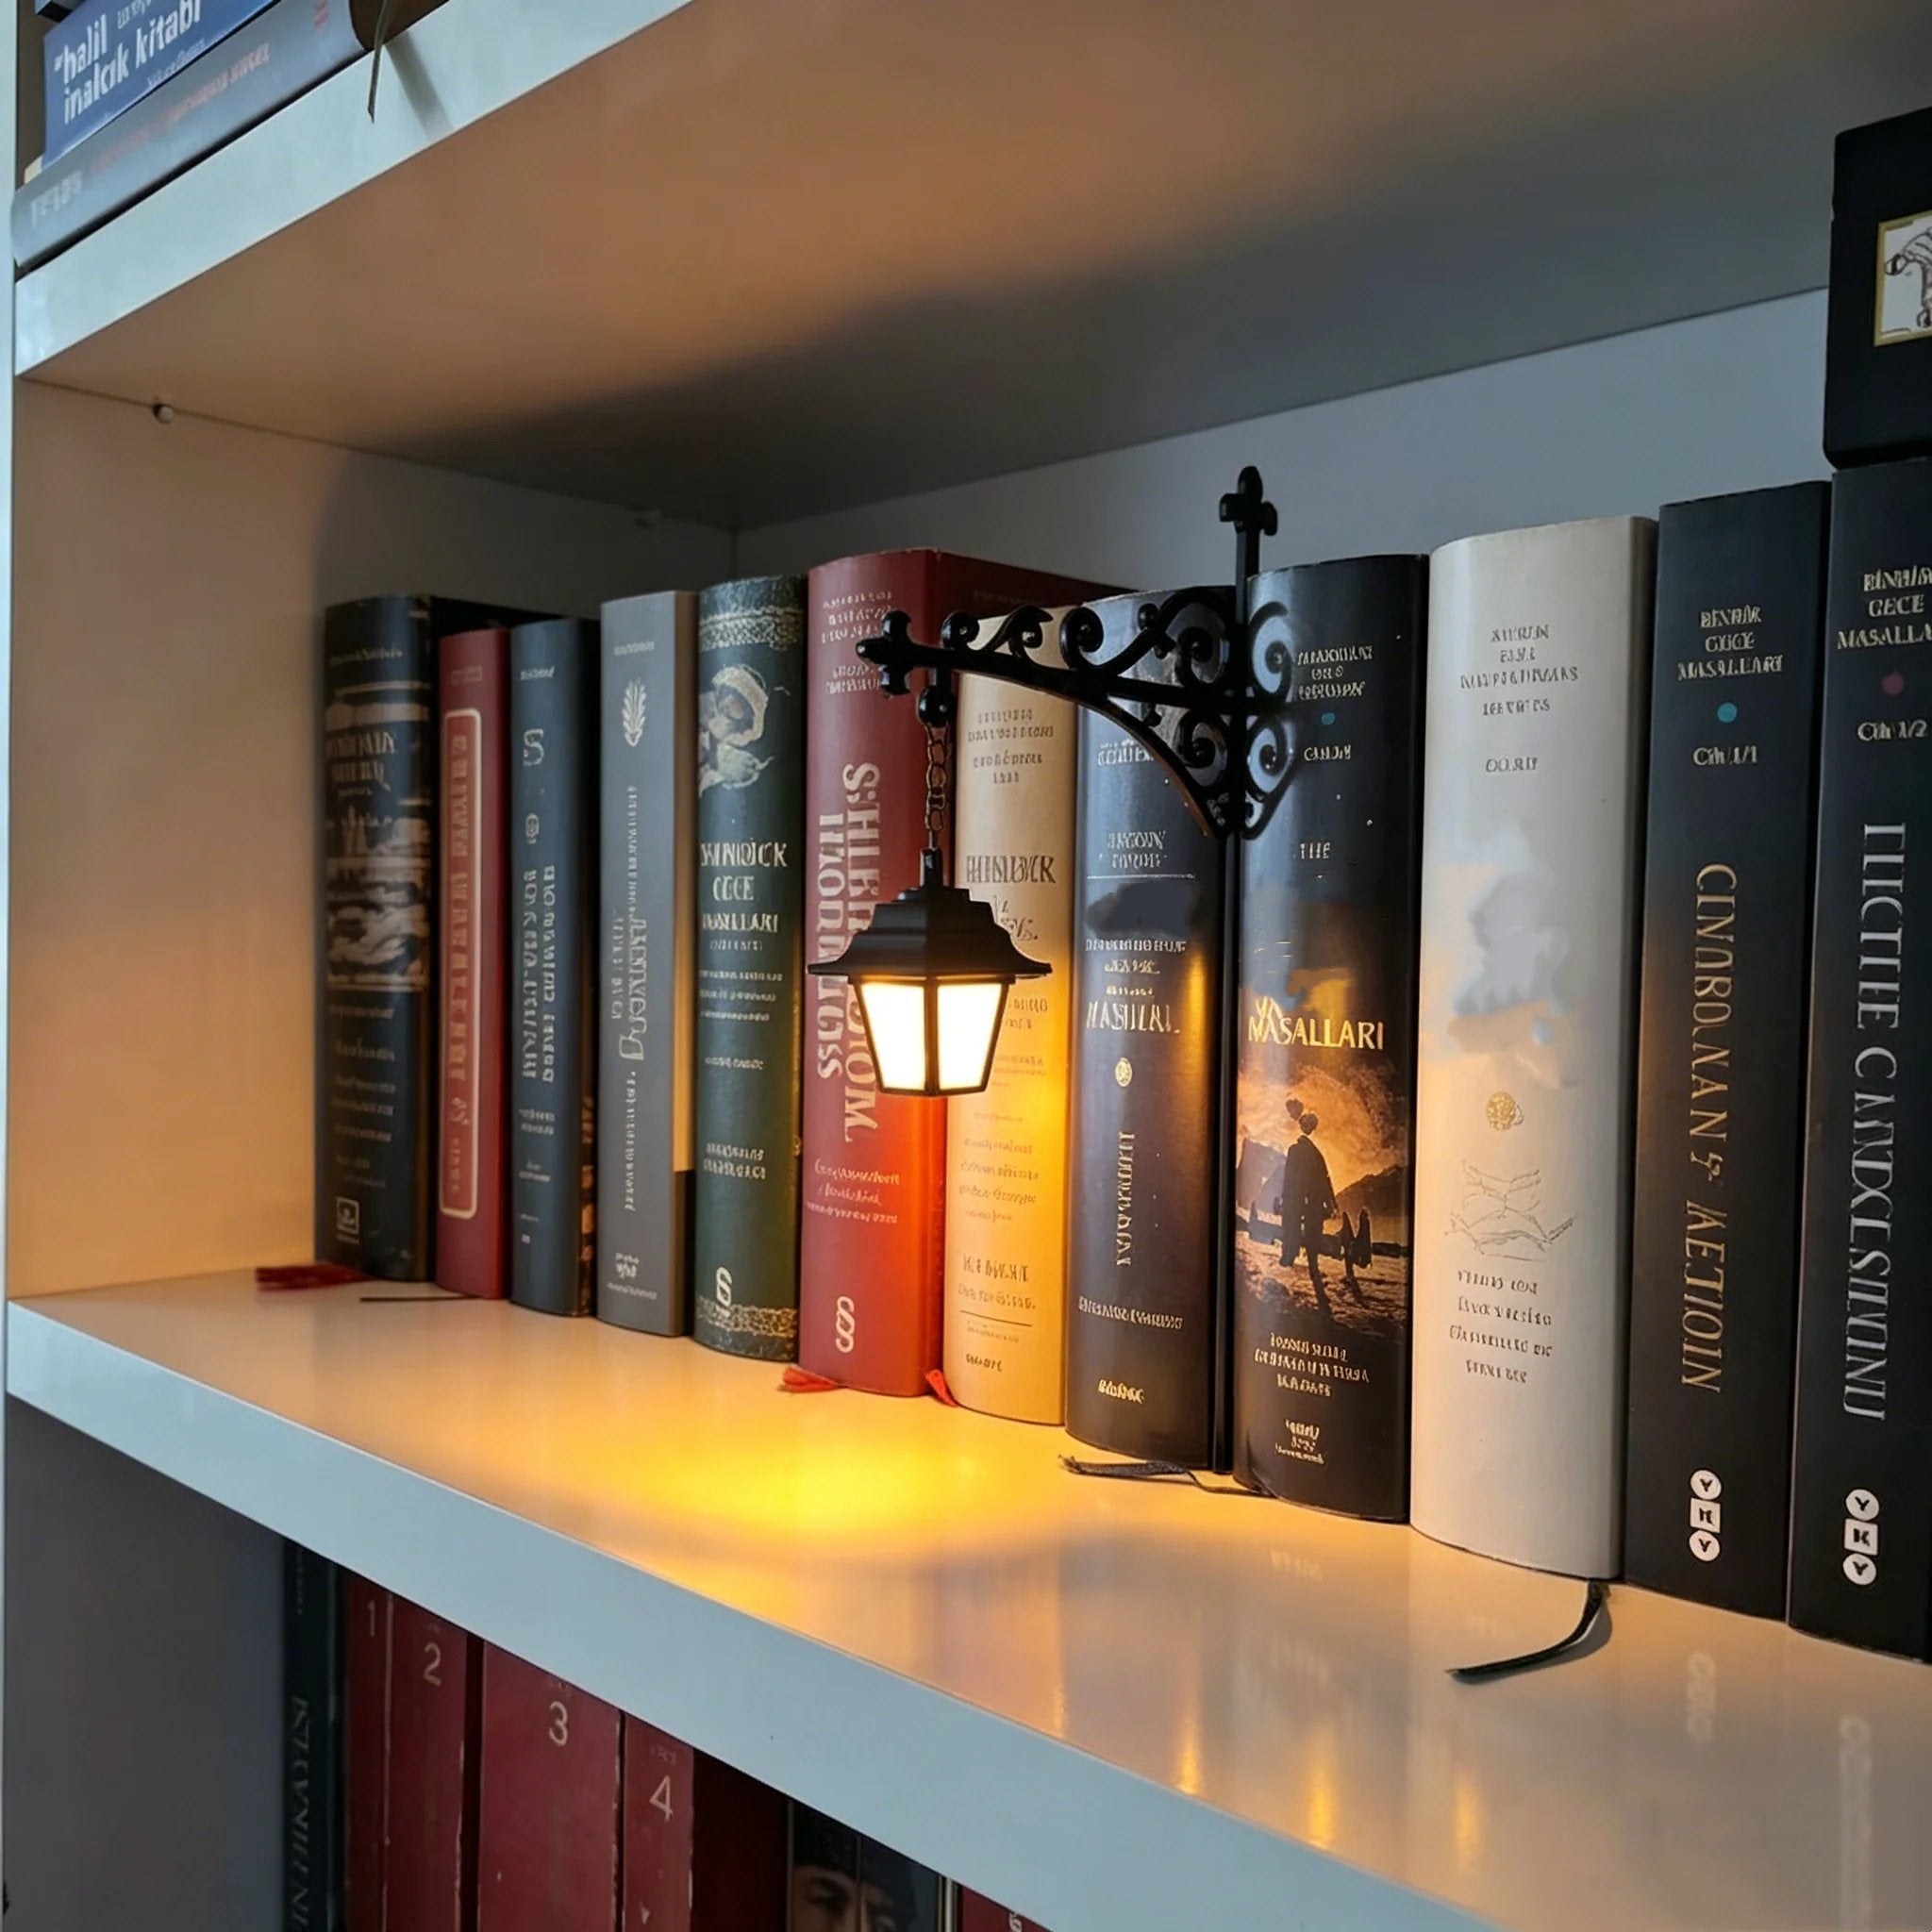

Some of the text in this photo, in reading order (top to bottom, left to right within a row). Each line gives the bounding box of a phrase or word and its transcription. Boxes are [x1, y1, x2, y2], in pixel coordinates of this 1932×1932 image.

[1248, 1015, 1384, 1051] MASALLARI
[424, 1642, 442, 1687] 2
[549, 1701, 568, 1745] 3
[649, 1775, 674, 1823] 4
